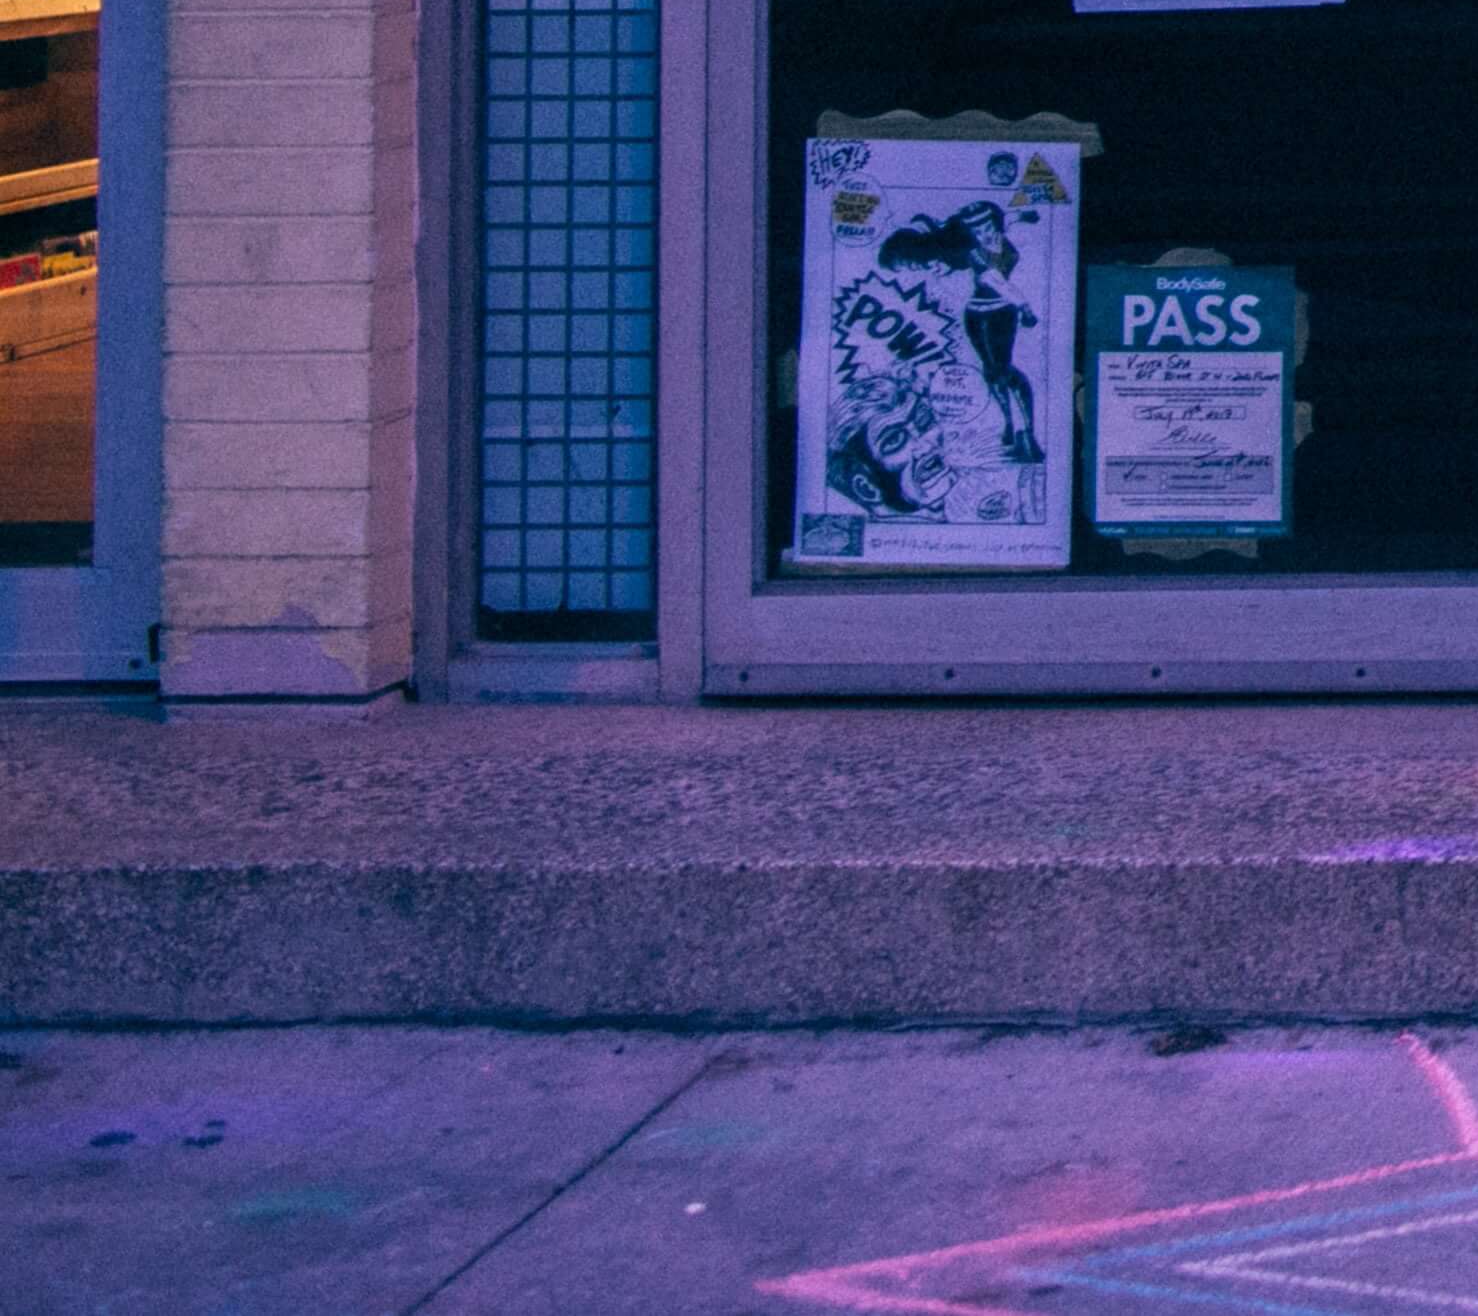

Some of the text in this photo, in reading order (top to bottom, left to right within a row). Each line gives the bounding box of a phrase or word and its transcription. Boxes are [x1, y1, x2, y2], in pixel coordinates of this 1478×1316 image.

[1157, 277, 1226, 293] BodySafe
[845, 294, 952, 368] POW!
[1123, 294, 1261, 346] PASS
